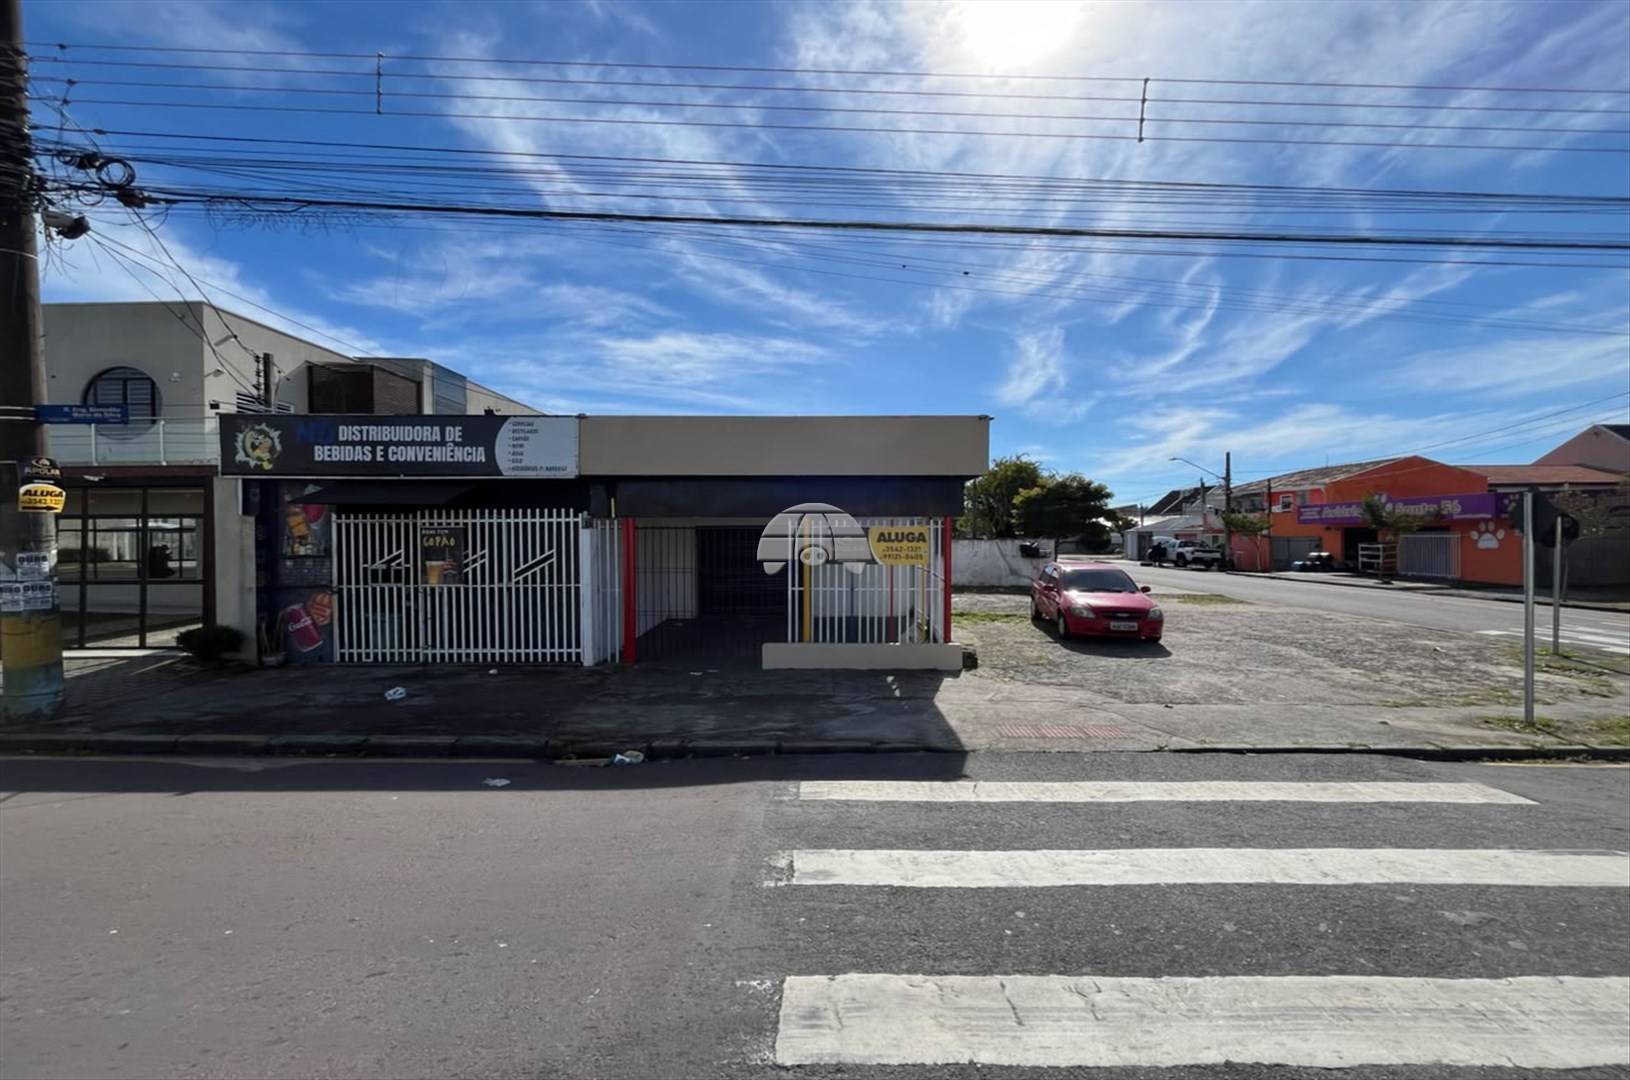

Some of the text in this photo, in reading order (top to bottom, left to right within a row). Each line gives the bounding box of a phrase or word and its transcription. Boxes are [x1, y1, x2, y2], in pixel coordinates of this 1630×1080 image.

[338, 425, 441, 442] DISTRIBUIDORA
[445, 426, 462, 442] DE
[314, 442, 486, 463] BEBIDAS E CONVENIÊNCIA
[22, 489, 64, 498] ALUGA
[876, 531, 927, 543] ALUGA
